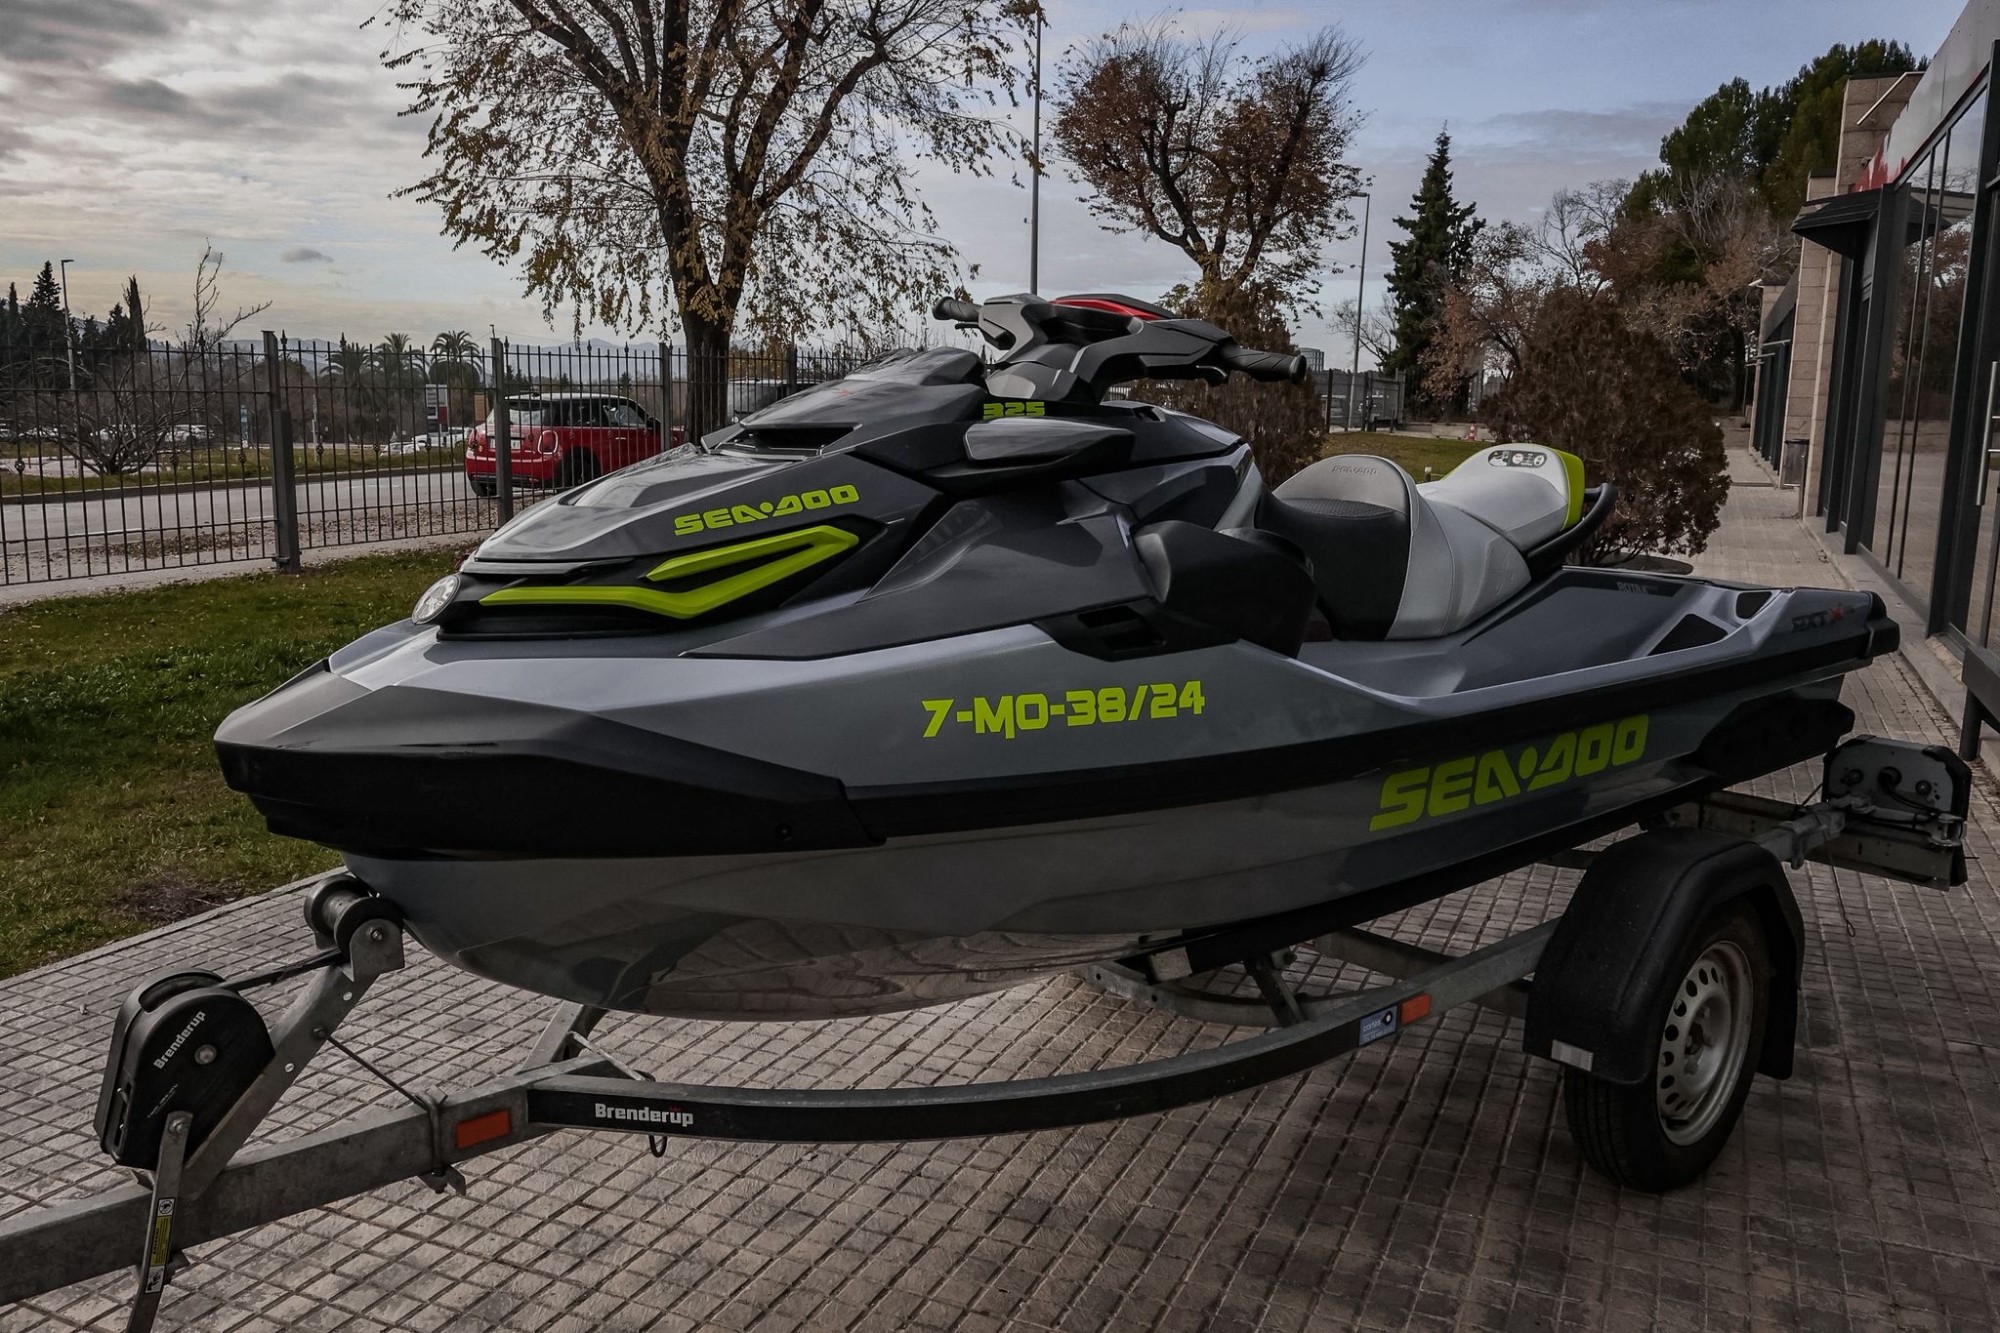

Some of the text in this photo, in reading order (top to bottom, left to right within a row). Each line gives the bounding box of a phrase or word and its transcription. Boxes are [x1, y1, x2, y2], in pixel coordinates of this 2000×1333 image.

[983, 401, 1045, 421] 325
[921, 680, 1206, 739] 7-MO-38/24
[153, 1011, 206, 1070] Brenderup
[594, 1103, 694, 1127] Brenderup
